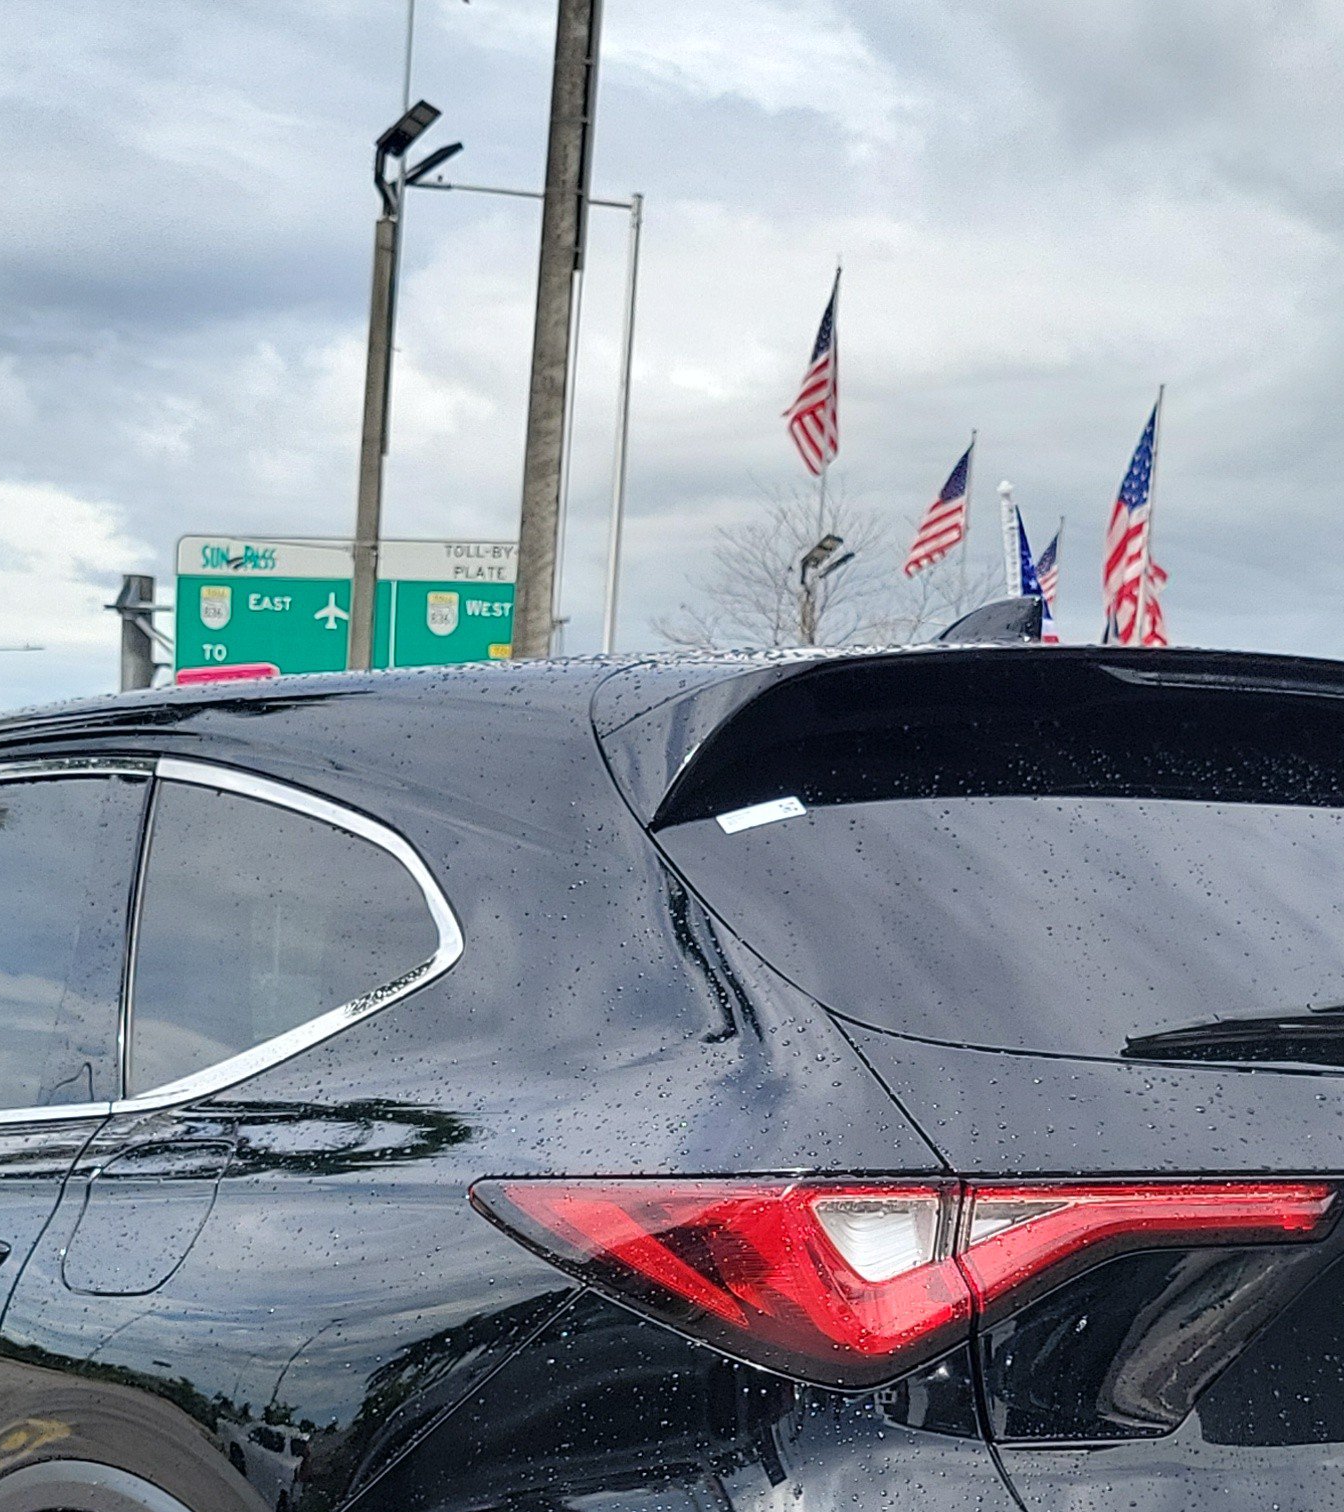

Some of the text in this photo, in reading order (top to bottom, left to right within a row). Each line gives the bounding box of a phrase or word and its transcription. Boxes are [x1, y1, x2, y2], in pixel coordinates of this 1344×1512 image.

[454, 566, 506, 580] PLATE
[248, 593, 292, 612] EAST
[465, 599, 514, 617] WEST
[202, 643, 228, 662] TO
